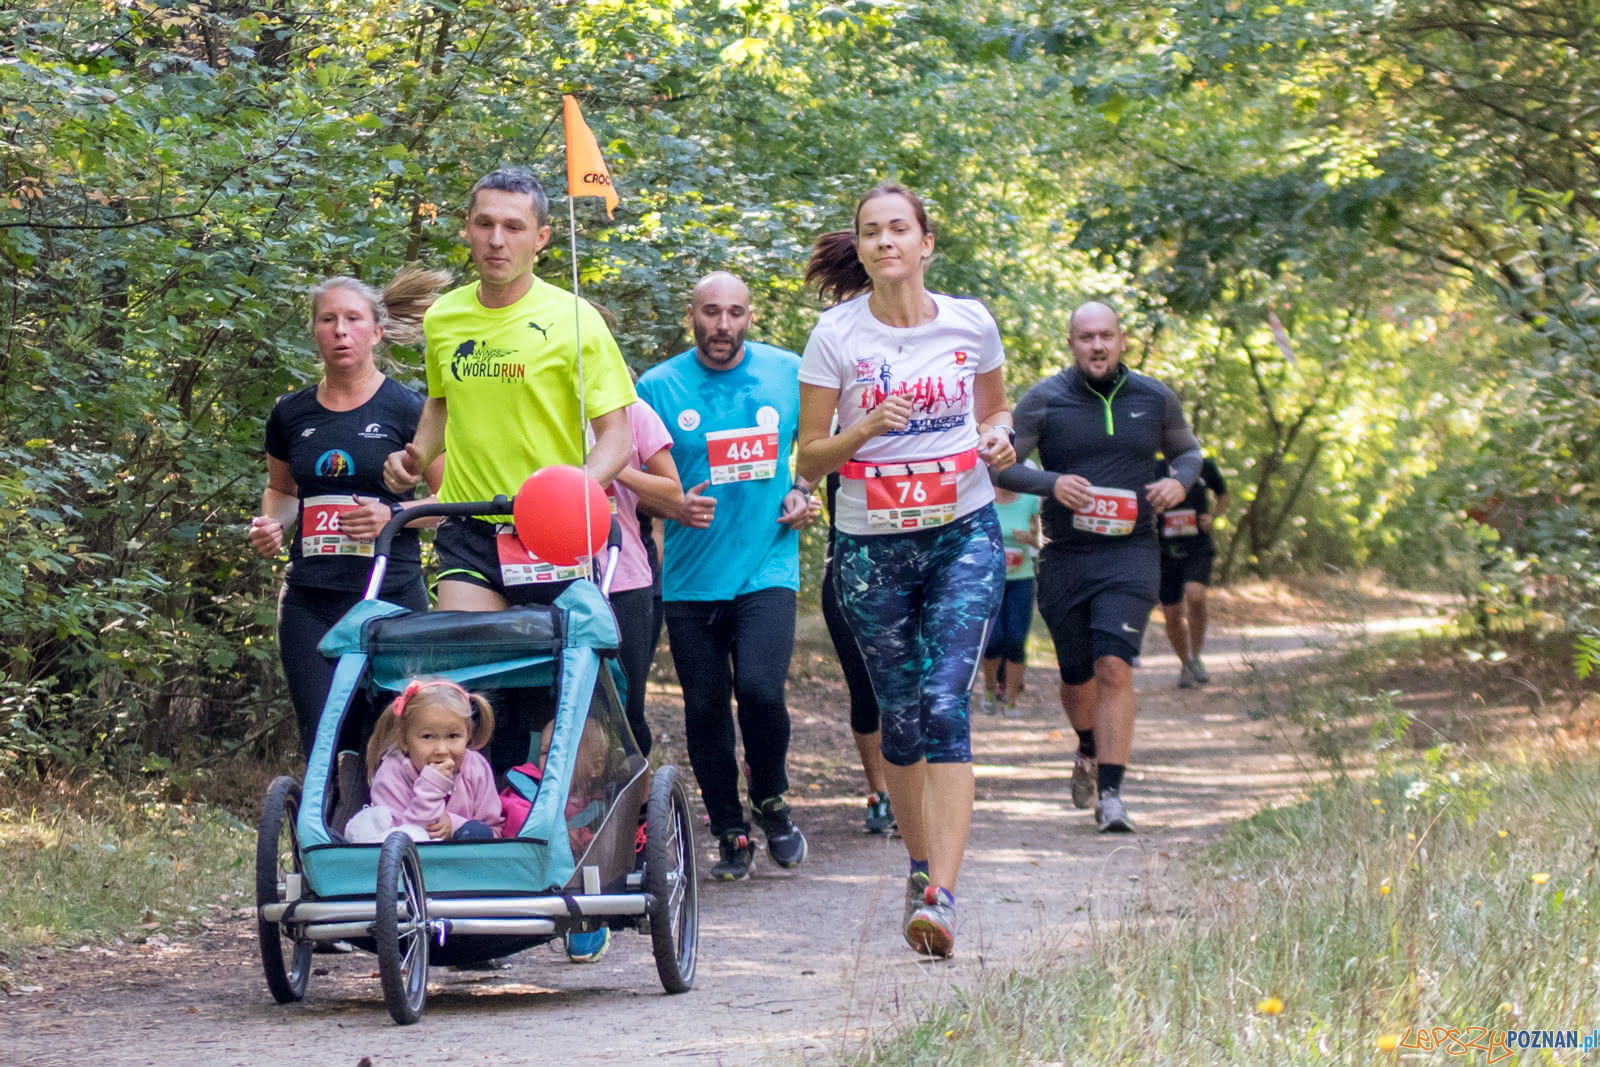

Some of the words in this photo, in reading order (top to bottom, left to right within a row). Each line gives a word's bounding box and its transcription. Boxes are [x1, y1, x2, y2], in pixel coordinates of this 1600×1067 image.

[726, 440, 765, 461] 464
[896, 480, 927, 504] 76
[315, 510, 340, 531] 26
